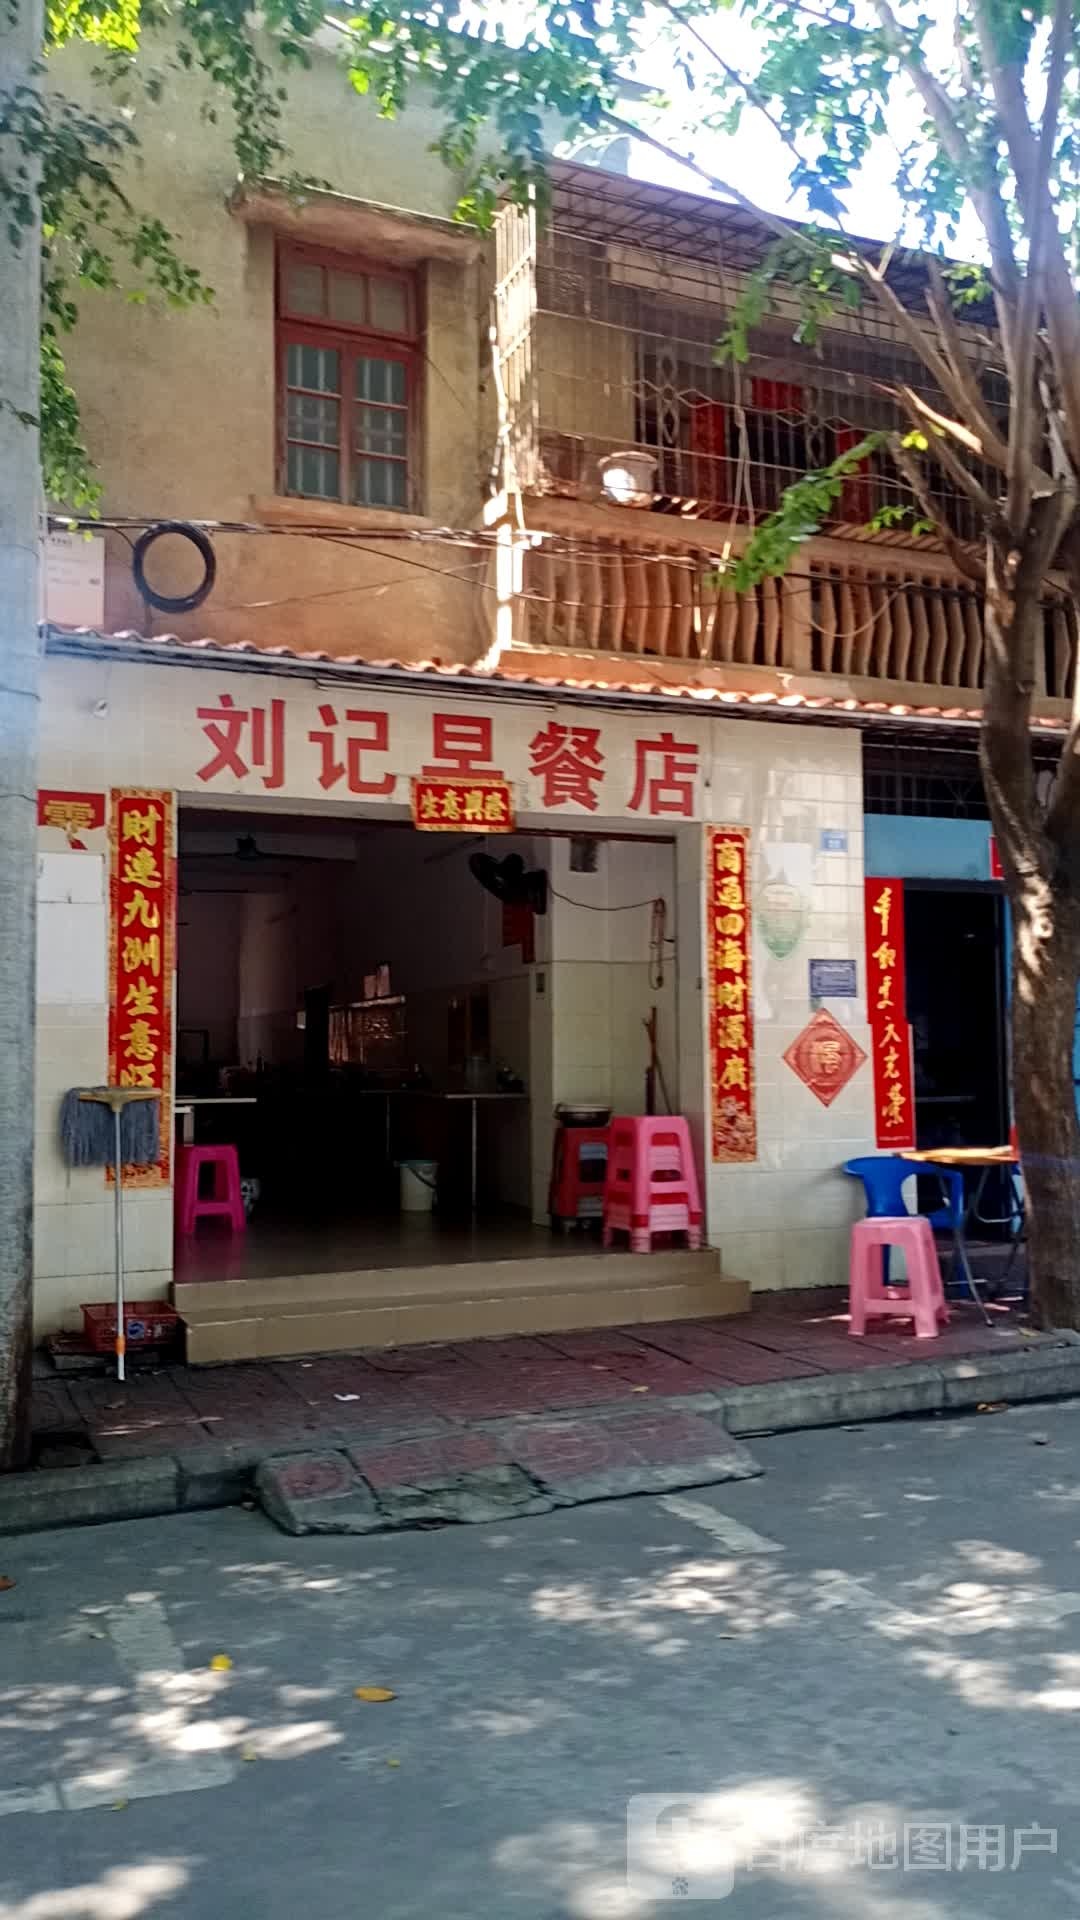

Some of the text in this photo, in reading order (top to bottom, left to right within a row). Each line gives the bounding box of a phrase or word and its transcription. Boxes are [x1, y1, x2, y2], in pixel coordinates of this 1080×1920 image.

[196, 694, 699, 817] 刘记早餐店
